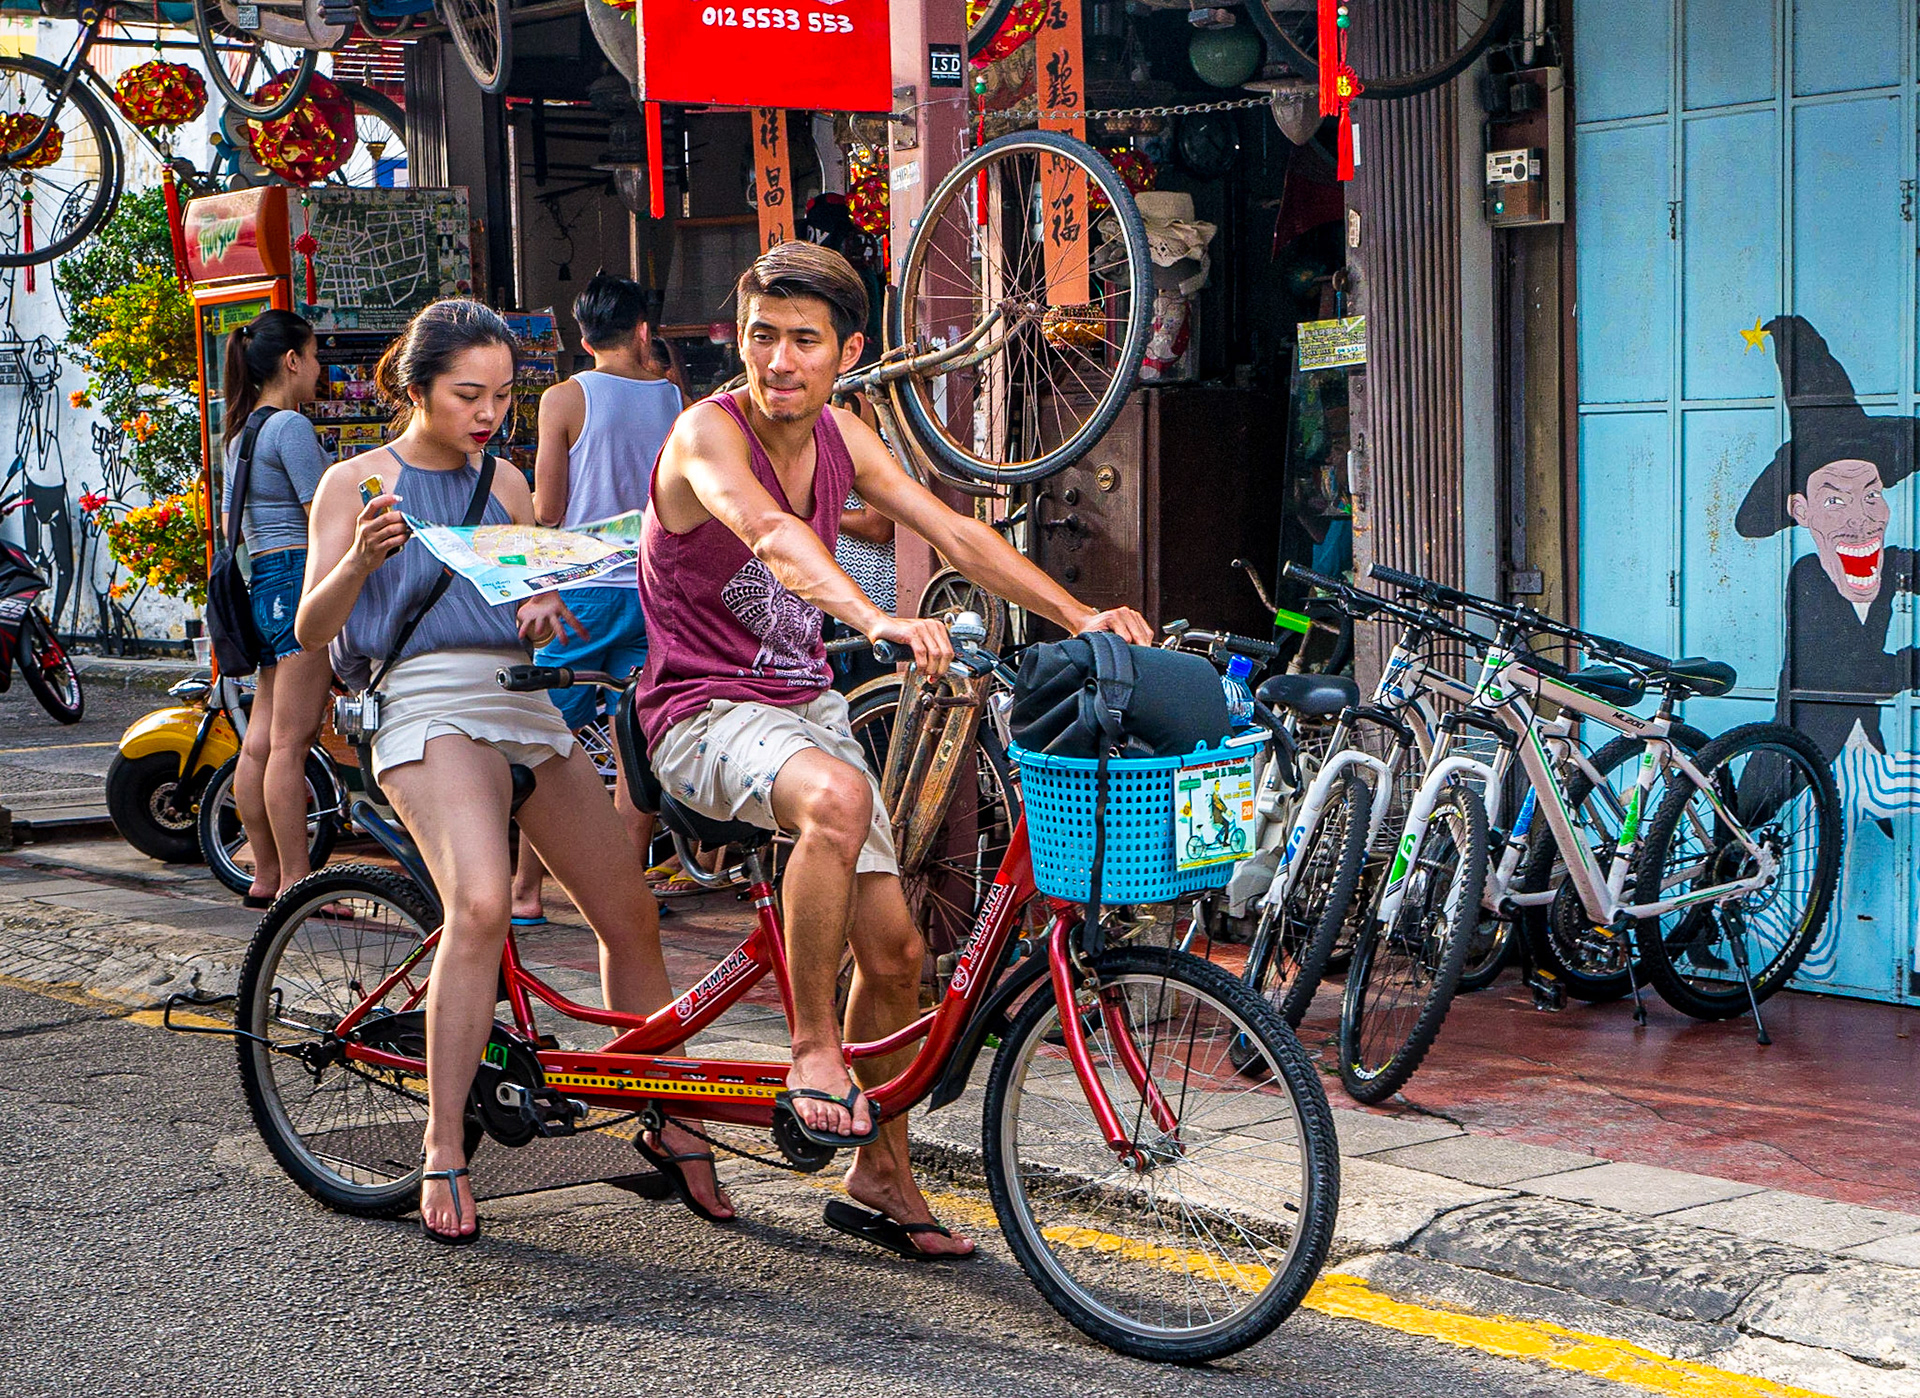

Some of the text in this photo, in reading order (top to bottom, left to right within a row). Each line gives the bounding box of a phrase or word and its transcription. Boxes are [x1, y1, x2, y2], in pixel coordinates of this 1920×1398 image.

[702, 6, 854, 33] 012 5533 553
[932, 57, 961, 72] LSD
[961, 883, 1004, 960] YAMAHA
[694, 948, 749, 999] YAMAHA
